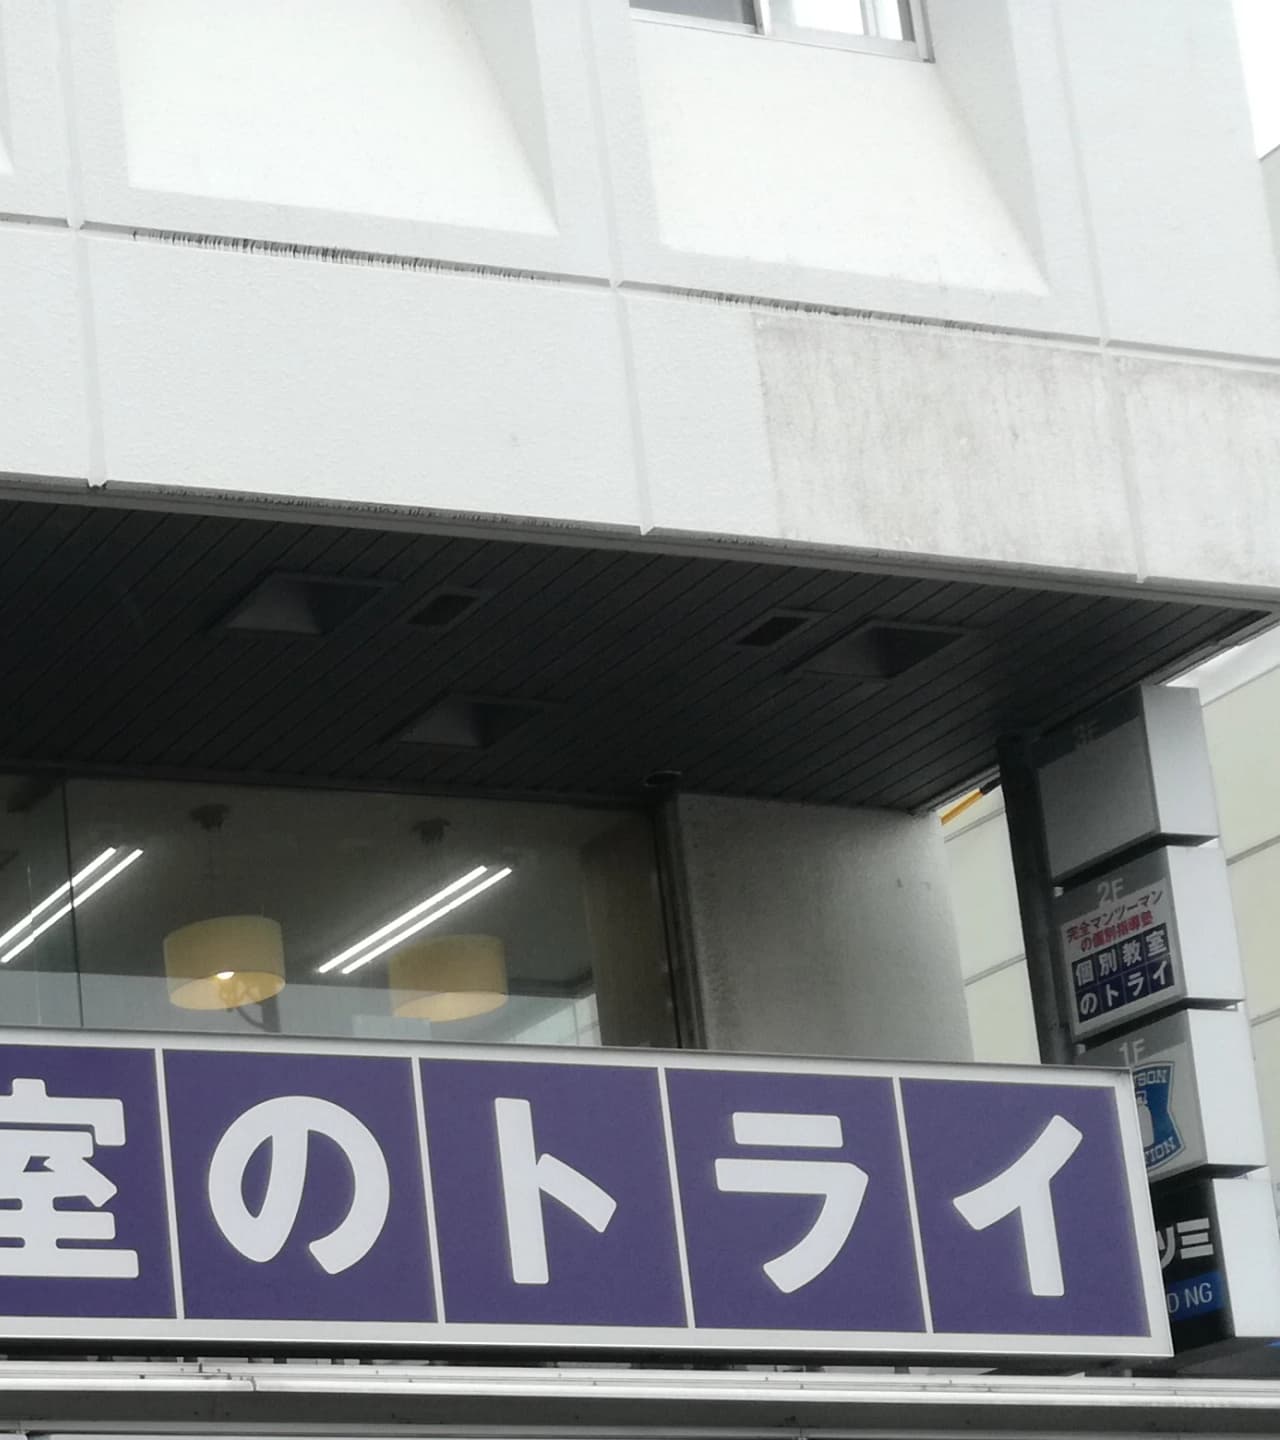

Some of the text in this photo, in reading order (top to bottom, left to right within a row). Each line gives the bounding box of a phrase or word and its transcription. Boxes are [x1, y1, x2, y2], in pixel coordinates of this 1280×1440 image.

[1066, 890, 1163, 943] 完全マンツーマン
[1097, 878, 1124, 903] 2F
[1075, 929, 1167, 987] 個別教室
[1080, 960, 1168, 1015] のトライ
